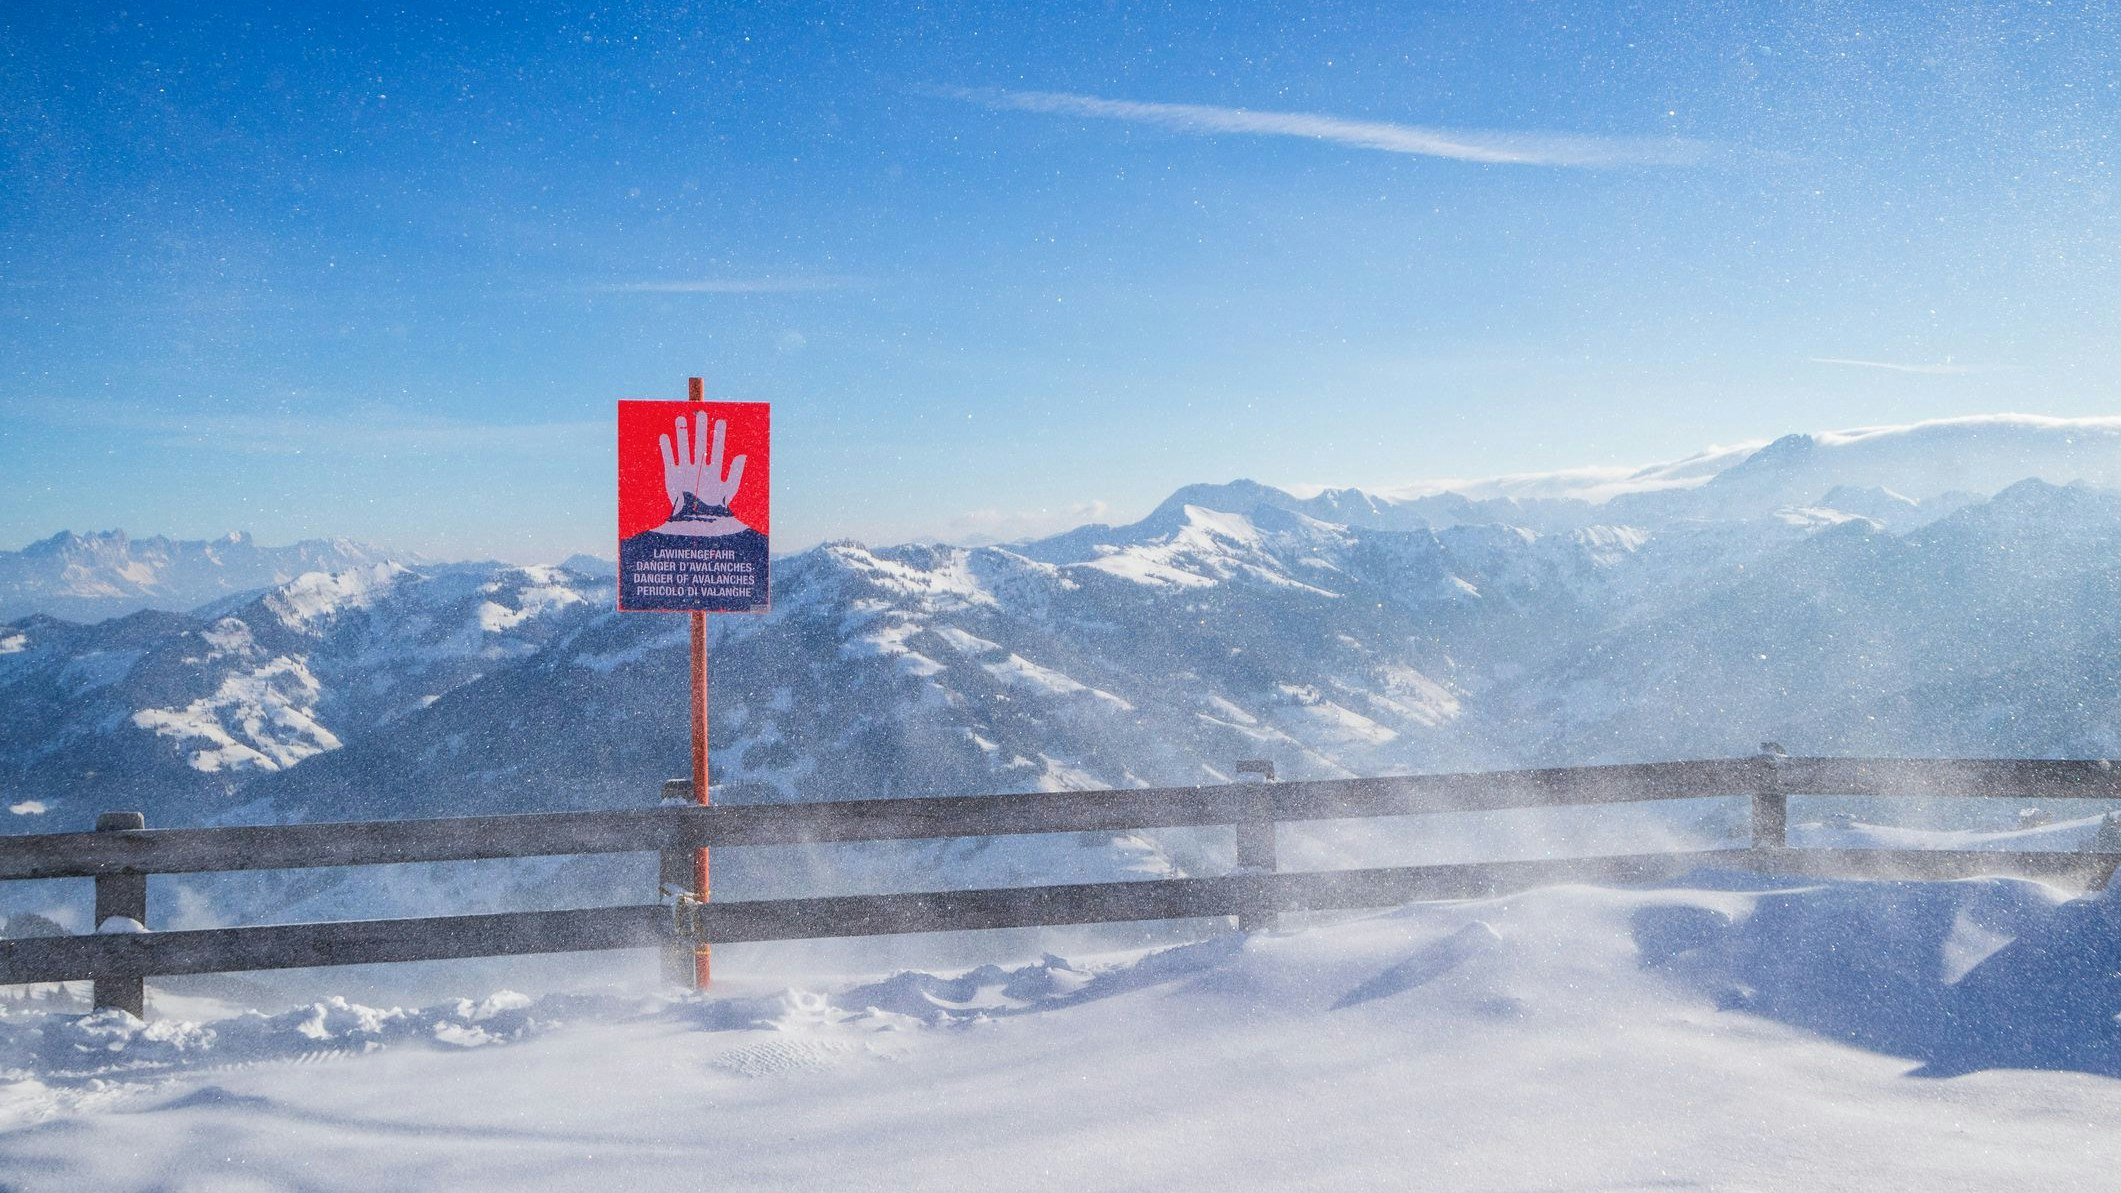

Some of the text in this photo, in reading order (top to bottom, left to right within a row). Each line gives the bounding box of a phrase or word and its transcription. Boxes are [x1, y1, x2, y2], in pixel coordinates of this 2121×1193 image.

[653, 549, 735, 560] LAWINENGEFAHR
[636, 561, 752, 572] DANGER D'AVALANCHES
[633, 573, 755, 585] DANGER OF AVALANCHES
[637, 586, 751, 597] PERICOLO DI VALANGHE
